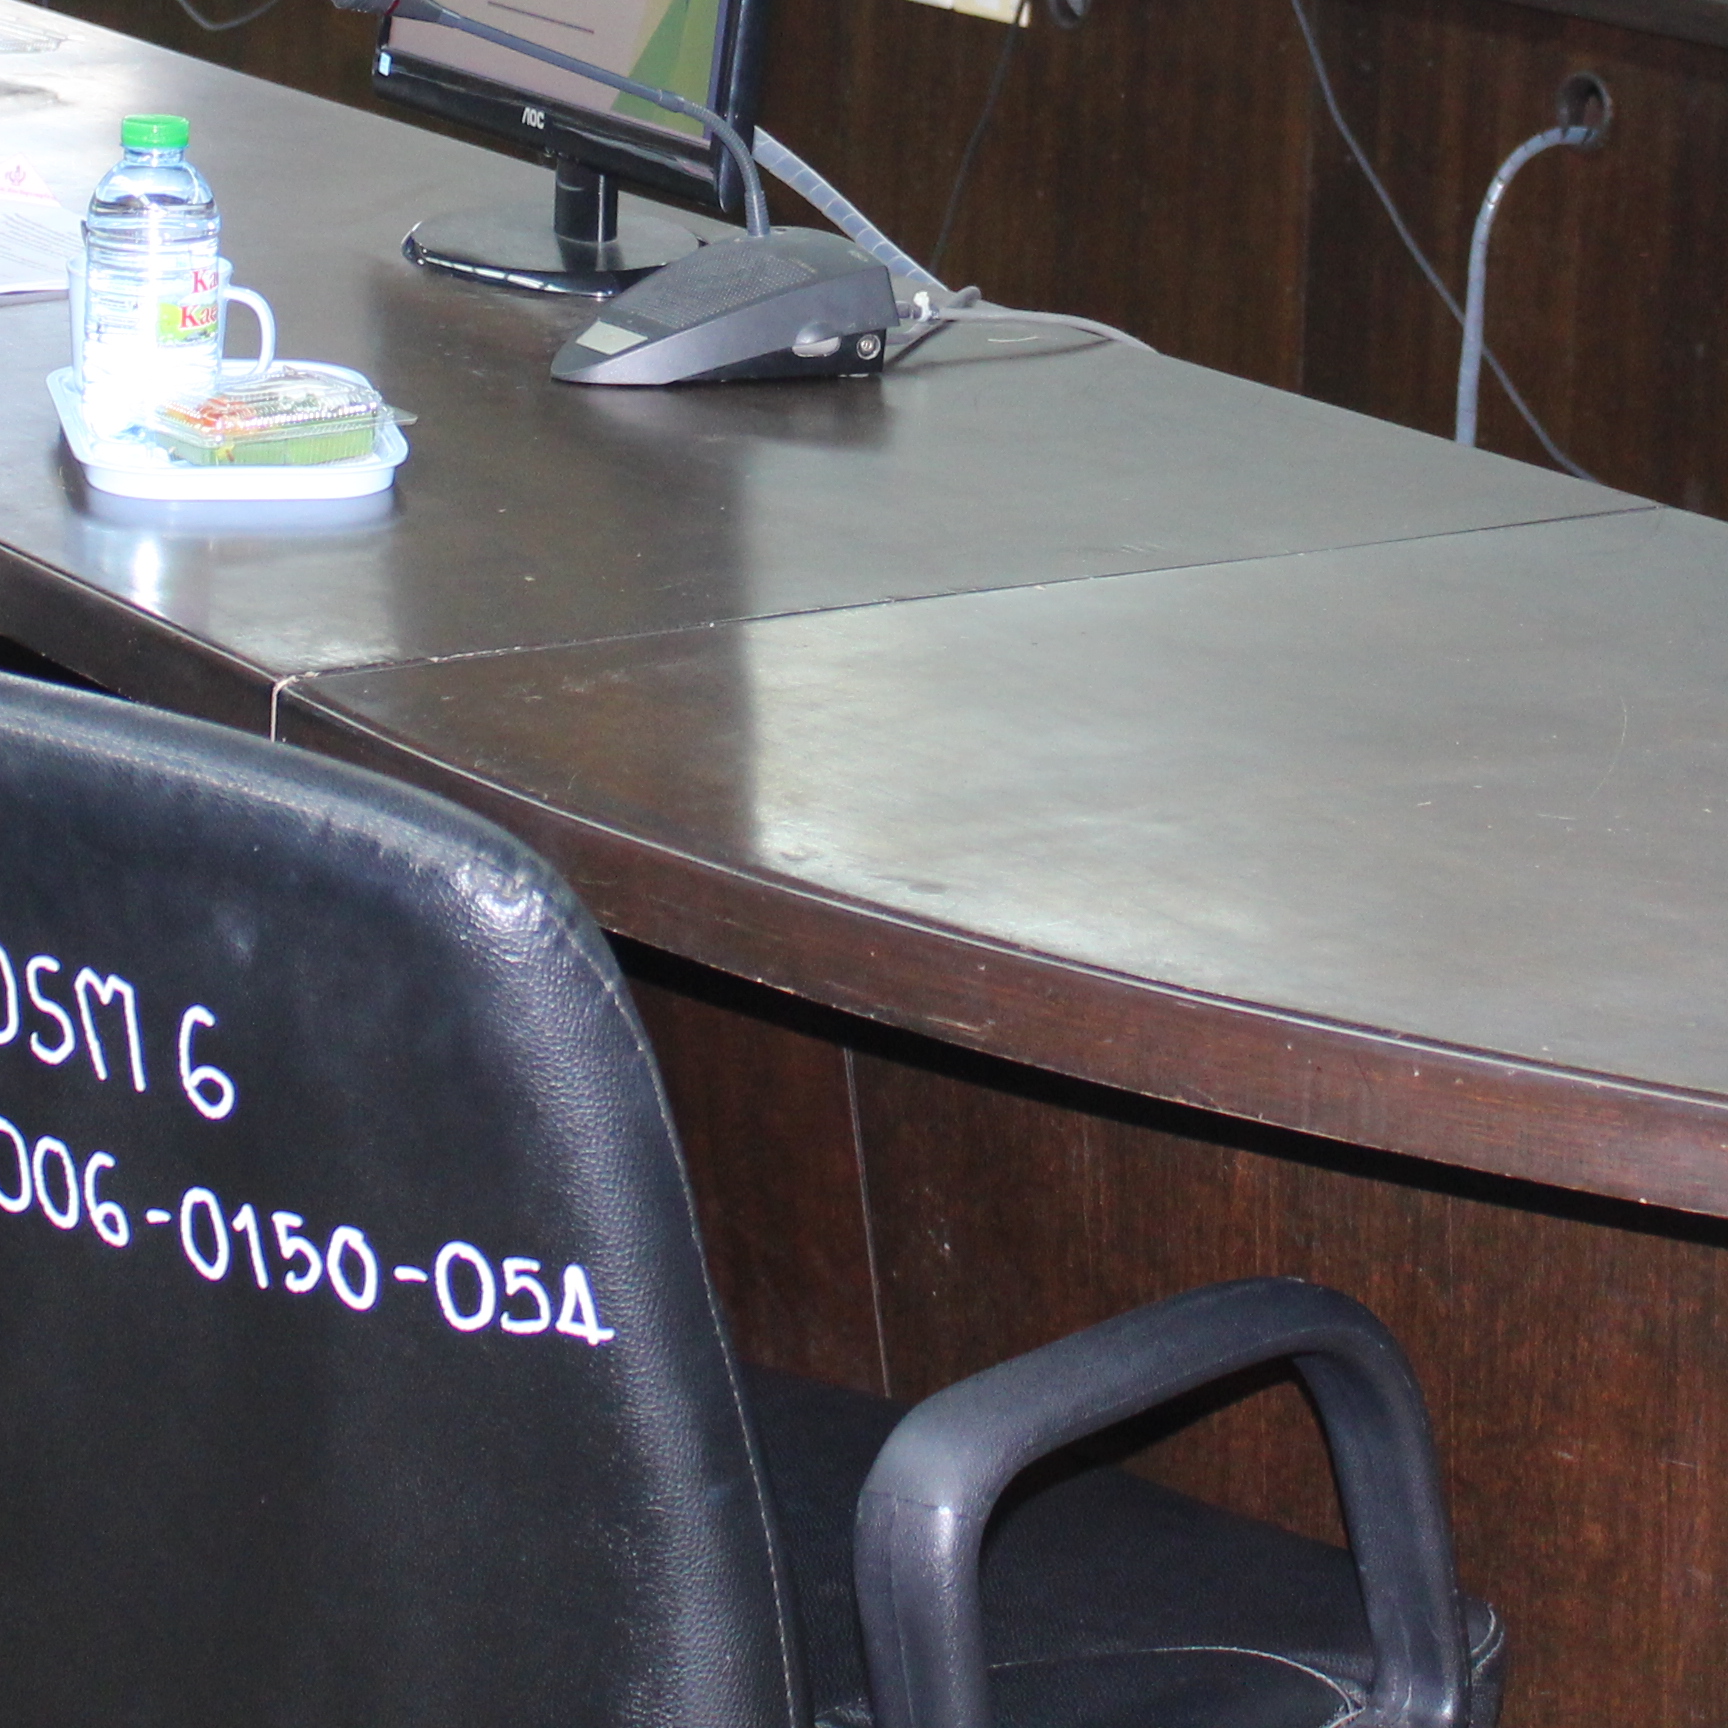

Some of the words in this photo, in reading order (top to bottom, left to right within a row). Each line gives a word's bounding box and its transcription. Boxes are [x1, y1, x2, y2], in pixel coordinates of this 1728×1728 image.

[192, 269, 219, 294] Ka
[179, 302, 219, 329] Kae
[178, 1003, 236, 1122] 6
